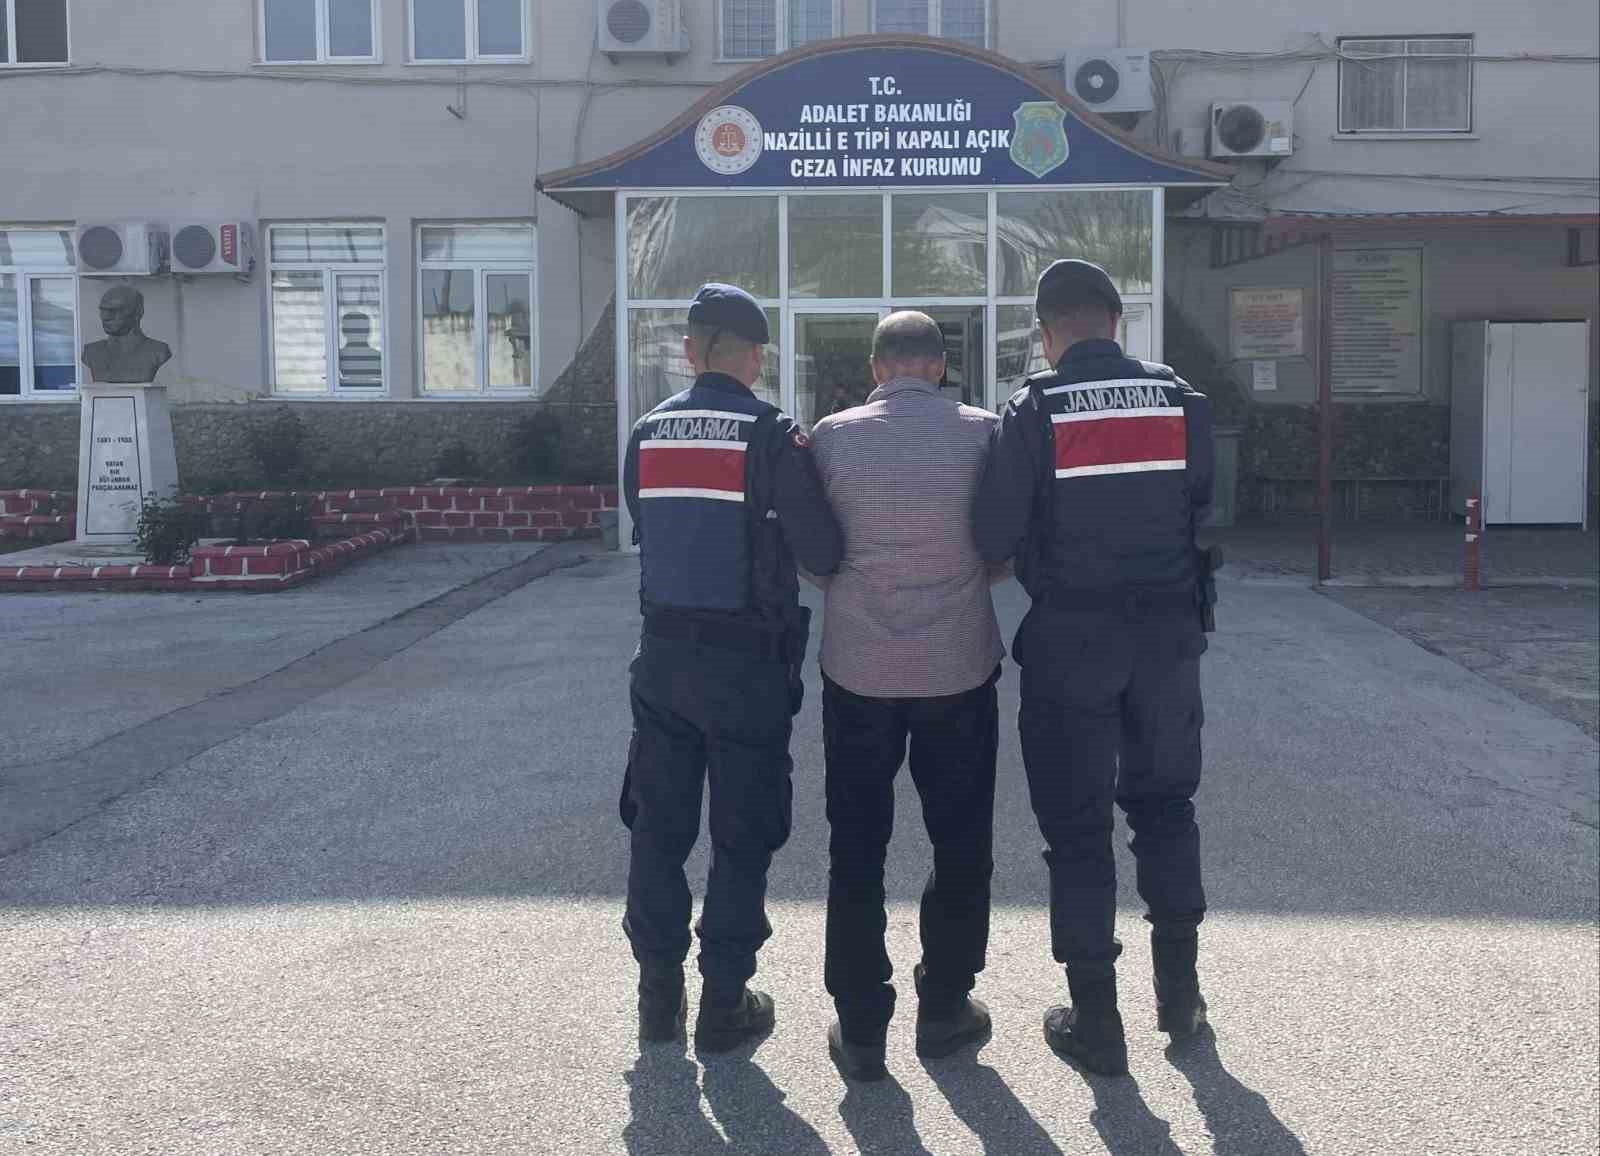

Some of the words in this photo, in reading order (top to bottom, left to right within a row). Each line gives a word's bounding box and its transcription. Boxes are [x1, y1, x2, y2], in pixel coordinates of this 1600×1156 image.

[868, 76, 902, 95] T.C.
[800, 104, 869, 123] ADALET
[874, 99, 972, 122] BAKANLIĞI
[764, 128, 832, 150] NAZİLLİ
[837, 132, 848, 149] E
[854, 127, 890, 149] TİPİ
[896, 130, 960, 149] KAPALI
[965, 129, 1010, 153] AÇIK
[790, 158, 837, 177] CEZA
[843, 154, 895, 177] İNFAZ
[901, 157, 982, 176] KURUMU
[1064, 385, 1170, 413] JANDARMA
[651, 417, 740, 441] JANDARMA
